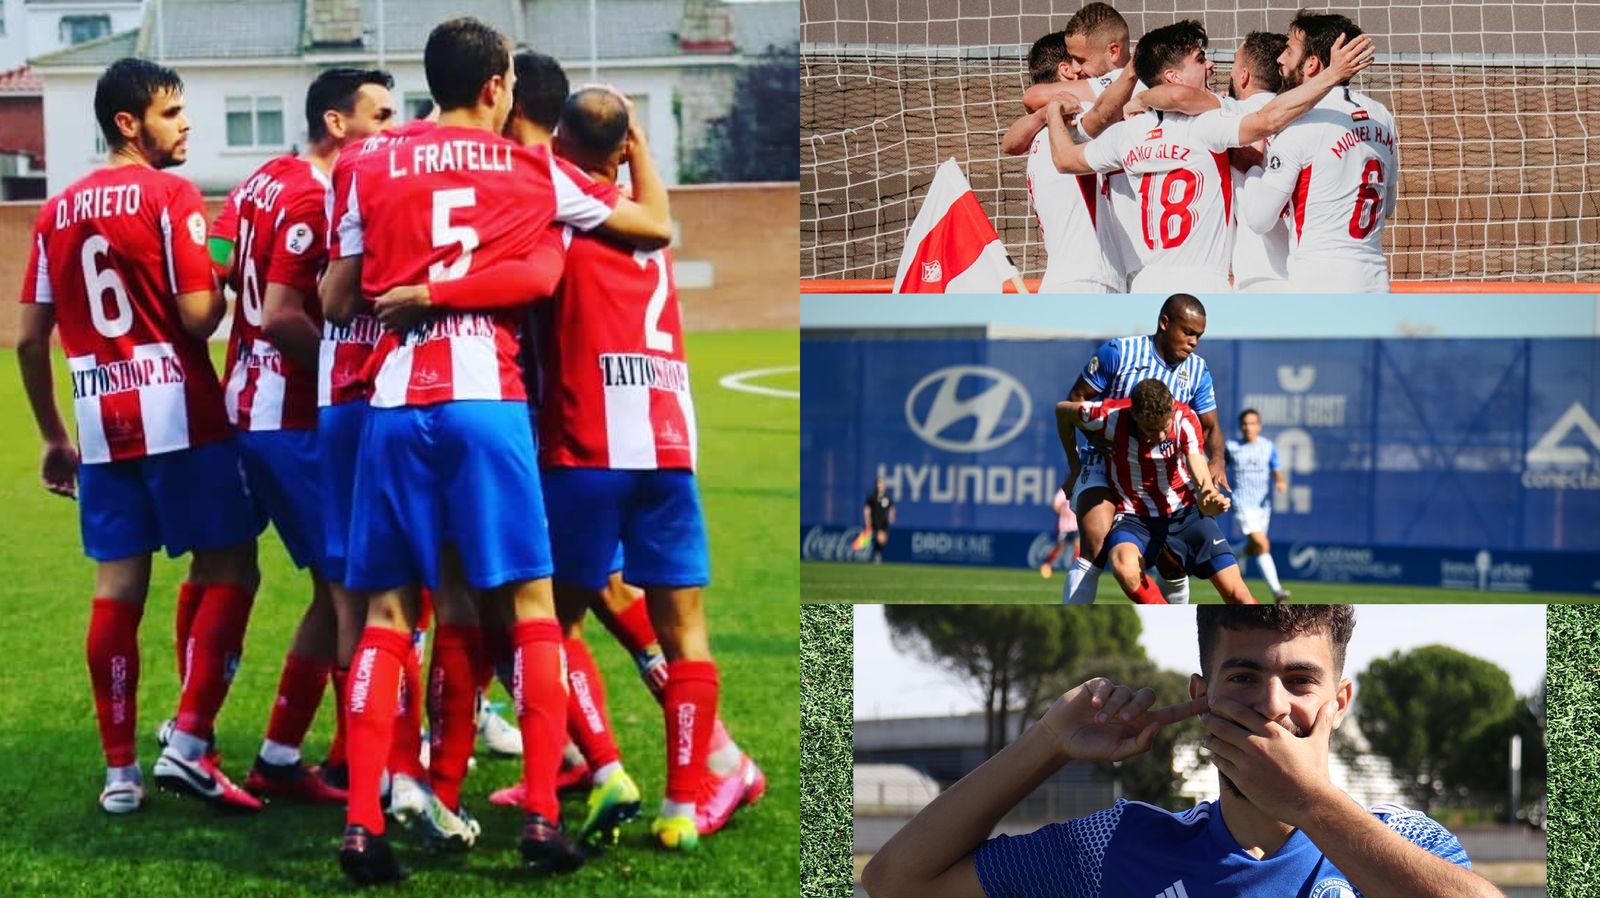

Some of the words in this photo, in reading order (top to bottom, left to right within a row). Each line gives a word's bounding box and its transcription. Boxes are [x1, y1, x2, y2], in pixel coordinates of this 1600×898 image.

[412, 140, 513, 175] FRATELLI
[1155, 144, 1191, 162] GLEZ
[1330, 126, 1371, 159] MIQUEL
[56, 198, 71, 230] D.
[73, 184, 141, 224] PRIETO
[1138, 167, 1205, 250] 18
[1348, 158, 1386, 240] 6
[429, 187, 479, 281] 5
[81, 234, 134, 339] 6
[634, 251, 674, 353] 2
[876, 464, 1056, 506] HYUNDAI
